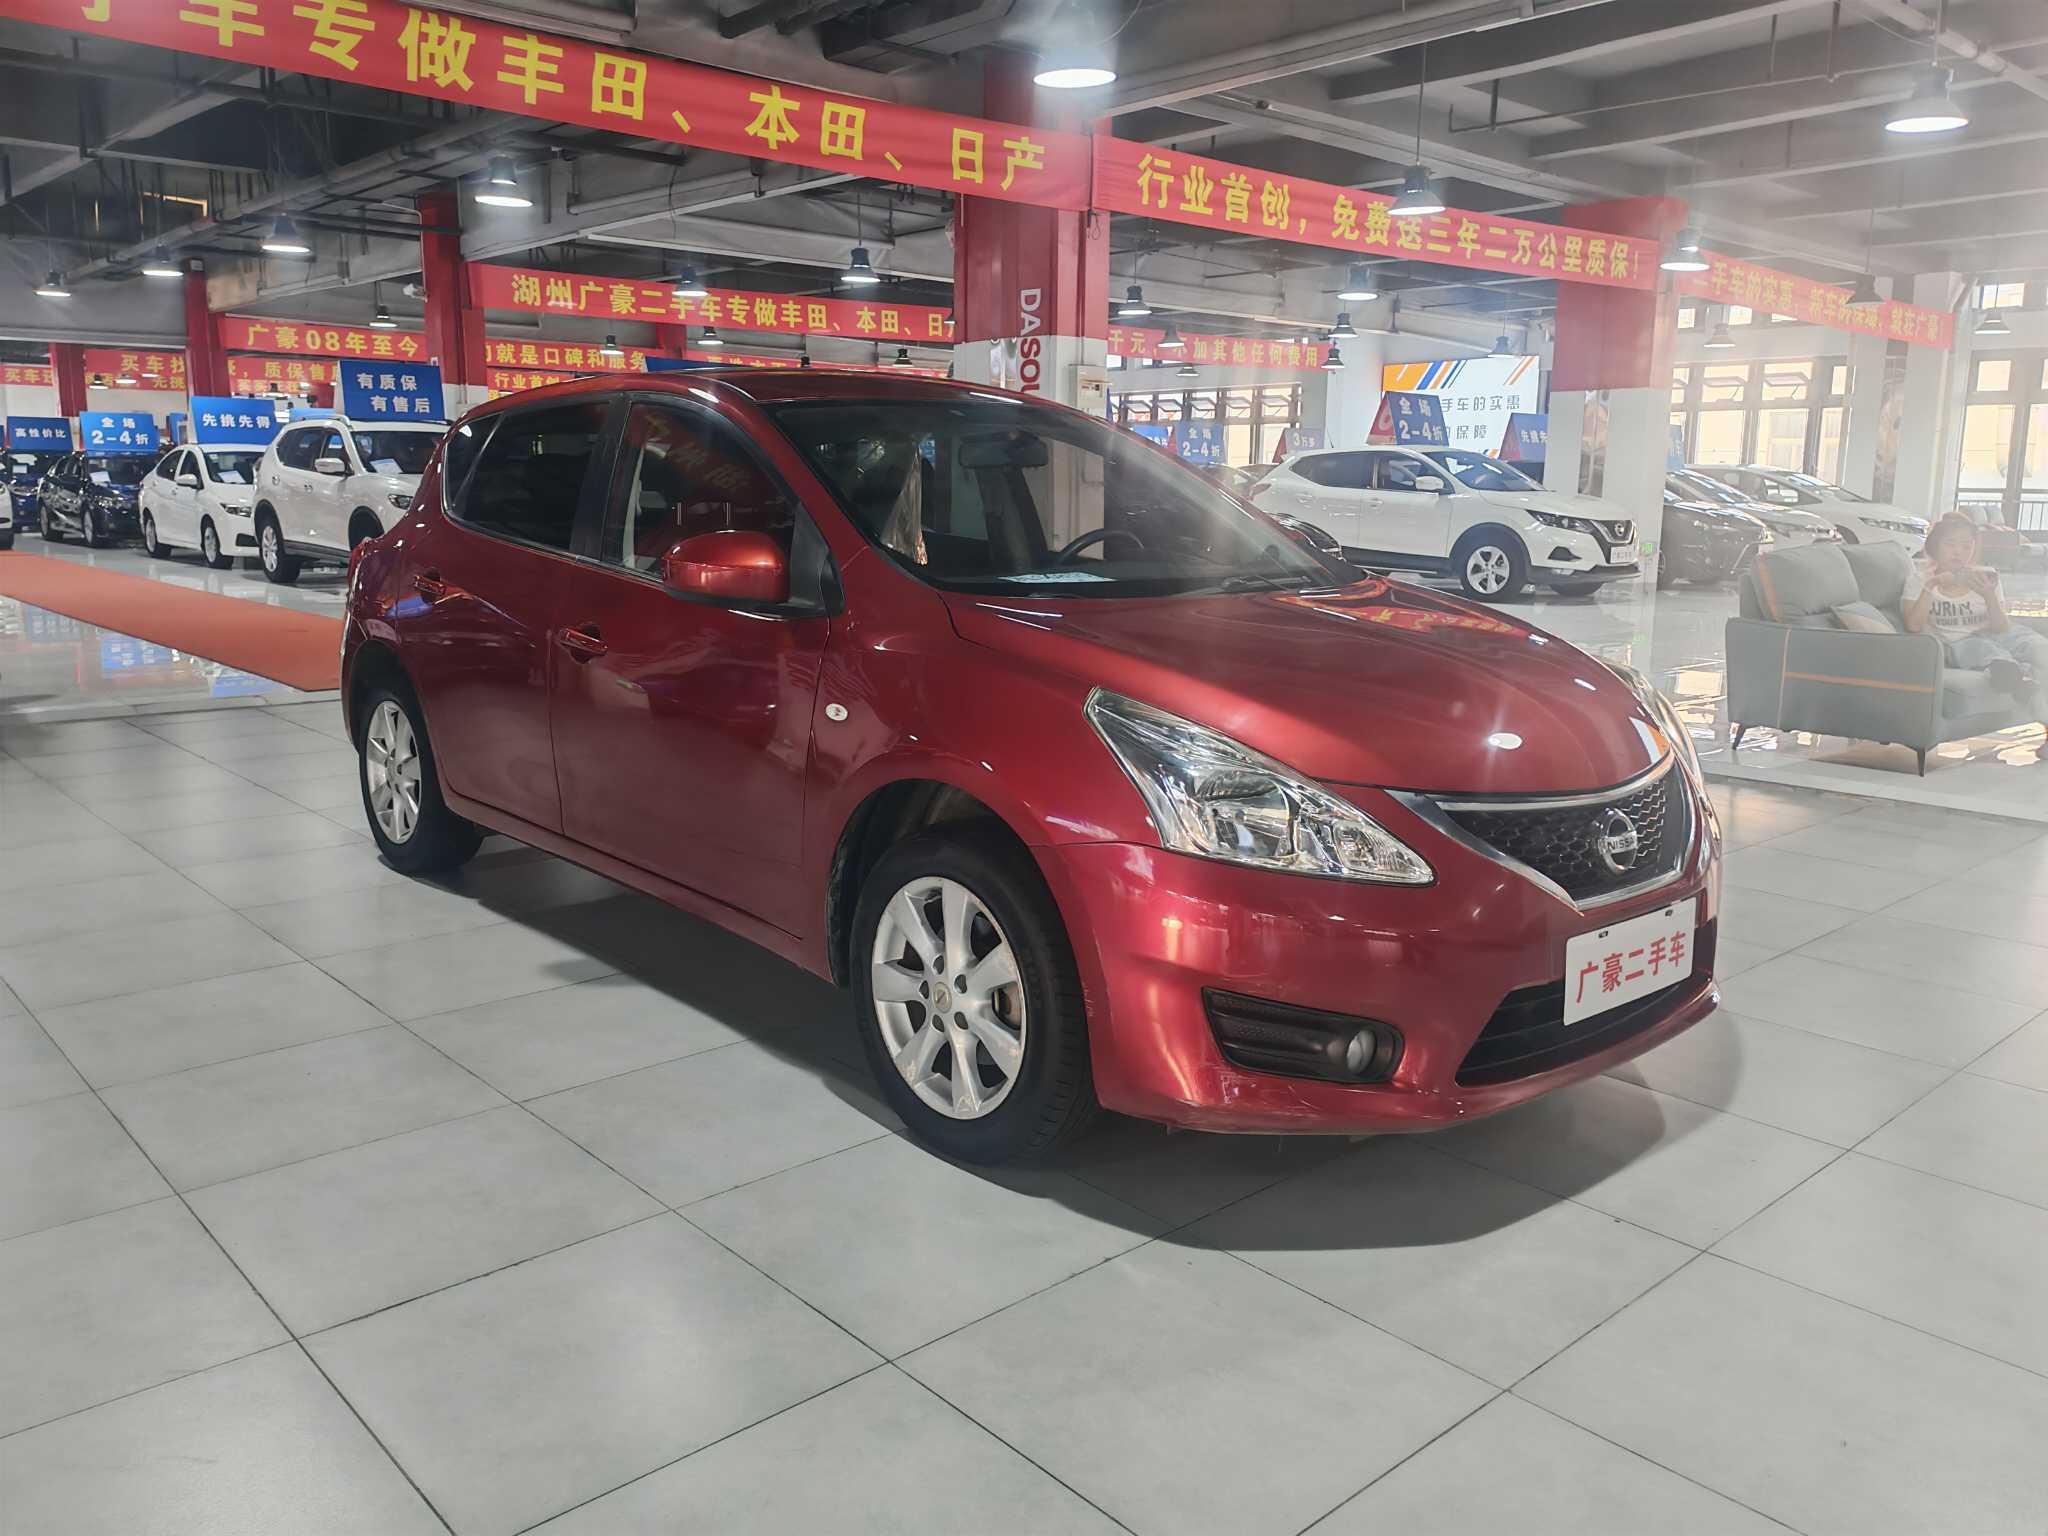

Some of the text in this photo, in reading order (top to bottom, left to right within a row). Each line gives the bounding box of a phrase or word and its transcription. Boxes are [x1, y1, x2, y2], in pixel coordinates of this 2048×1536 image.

[247, 324, 419, 357] 广豪08年至今
[356, 372, 418, 391] 有质保
[370, 396, 431, 413] 有售后
[101, 417, 136, 429] 全场
[202, 413, 271, 428] 先挑先得
[15, 428, 66, 438] 高性价比
[91, 430, 149, 446] 2-4折
[1575, 930, 1687, 1004] 广豪二手车
